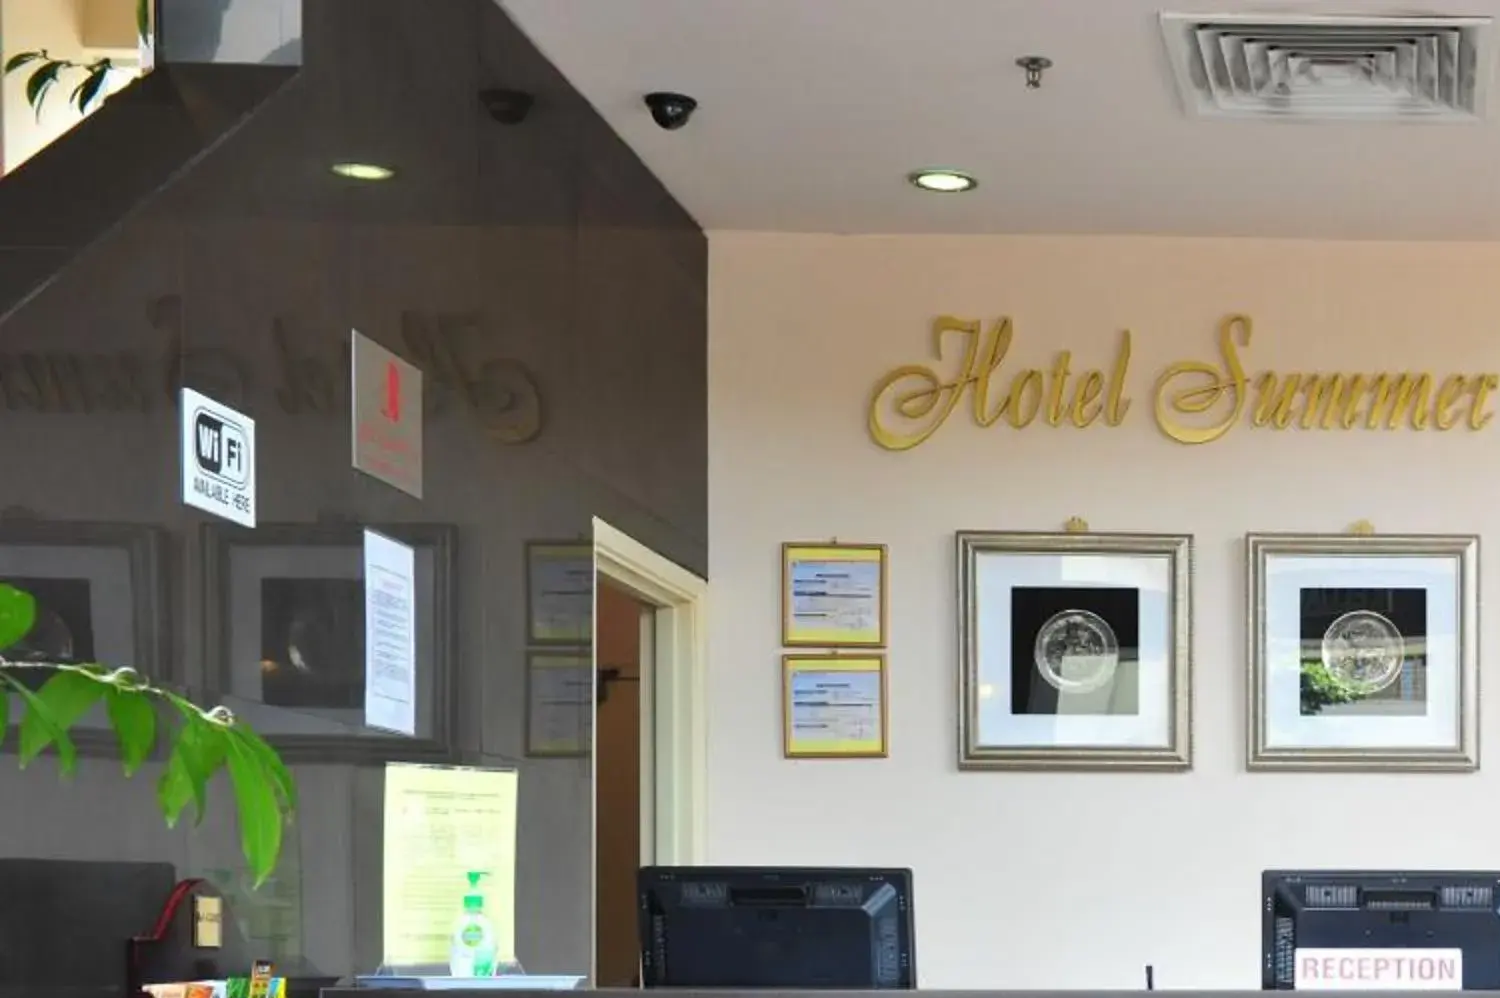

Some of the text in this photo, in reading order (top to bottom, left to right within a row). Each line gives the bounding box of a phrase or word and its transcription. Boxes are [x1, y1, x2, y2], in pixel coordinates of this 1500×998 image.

[868, 314, 1131, 451] Hotel
[1154, 314, 1499, 445] Summer
[1302, 957, 1456, 980] RECEPTION
